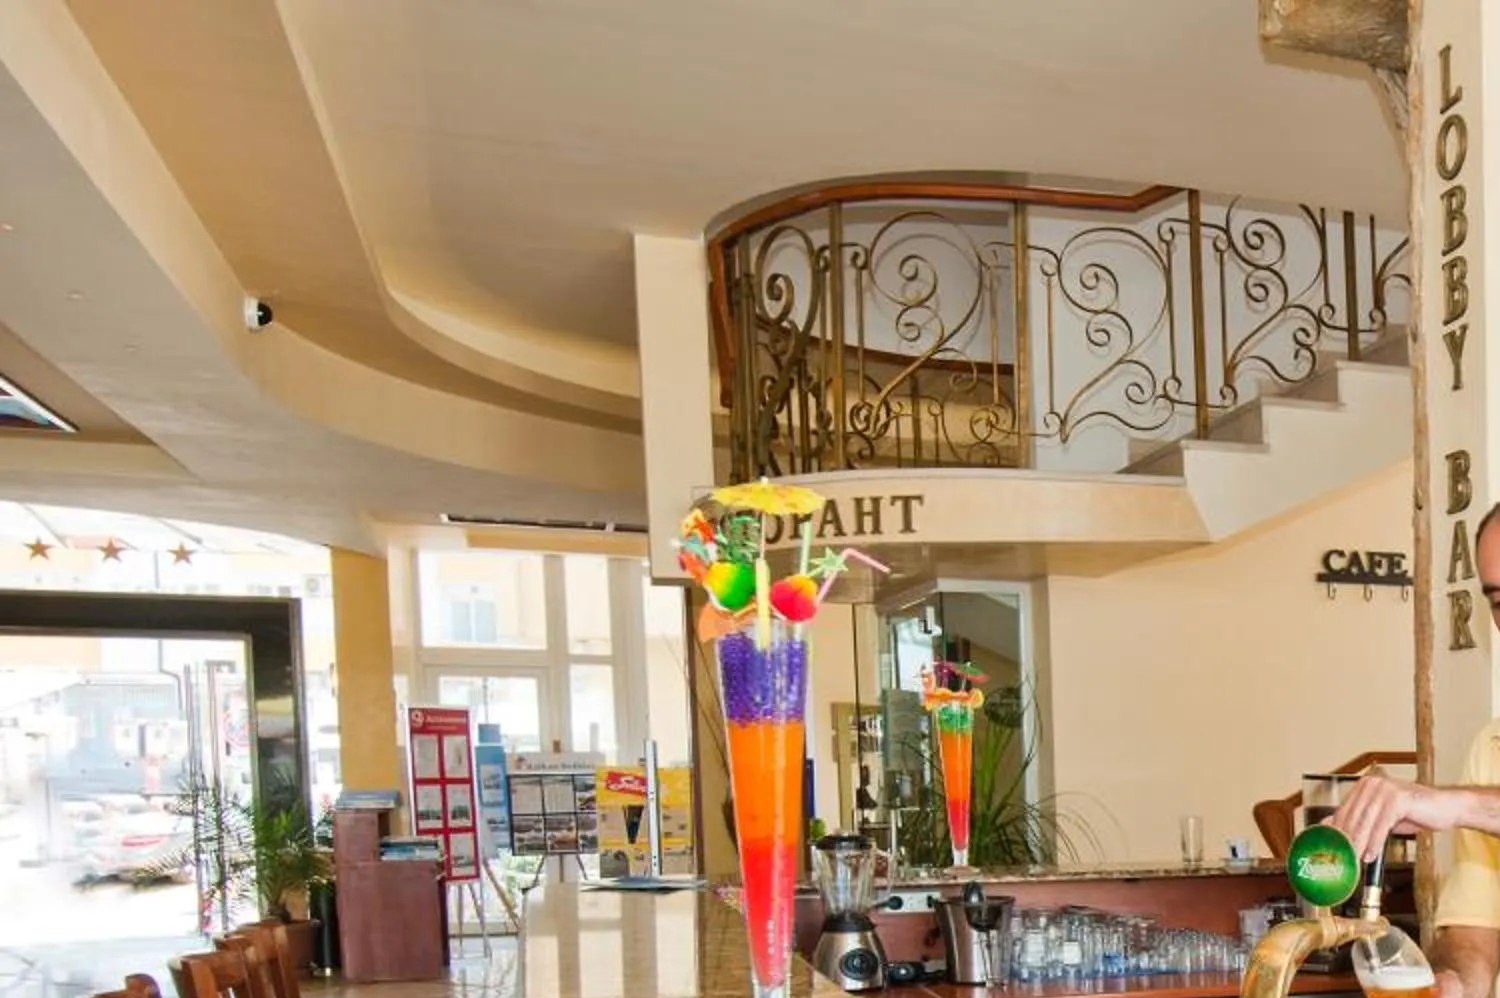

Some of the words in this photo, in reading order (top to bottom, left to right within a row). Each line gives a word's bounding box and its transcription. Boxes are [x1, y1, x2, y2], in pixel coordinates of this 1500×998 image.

[1435, 44, 1468, 391] LOBBY
[1322, 549, 1408, 578] CAFE
[1445, 449, 1477, 651] BAR
